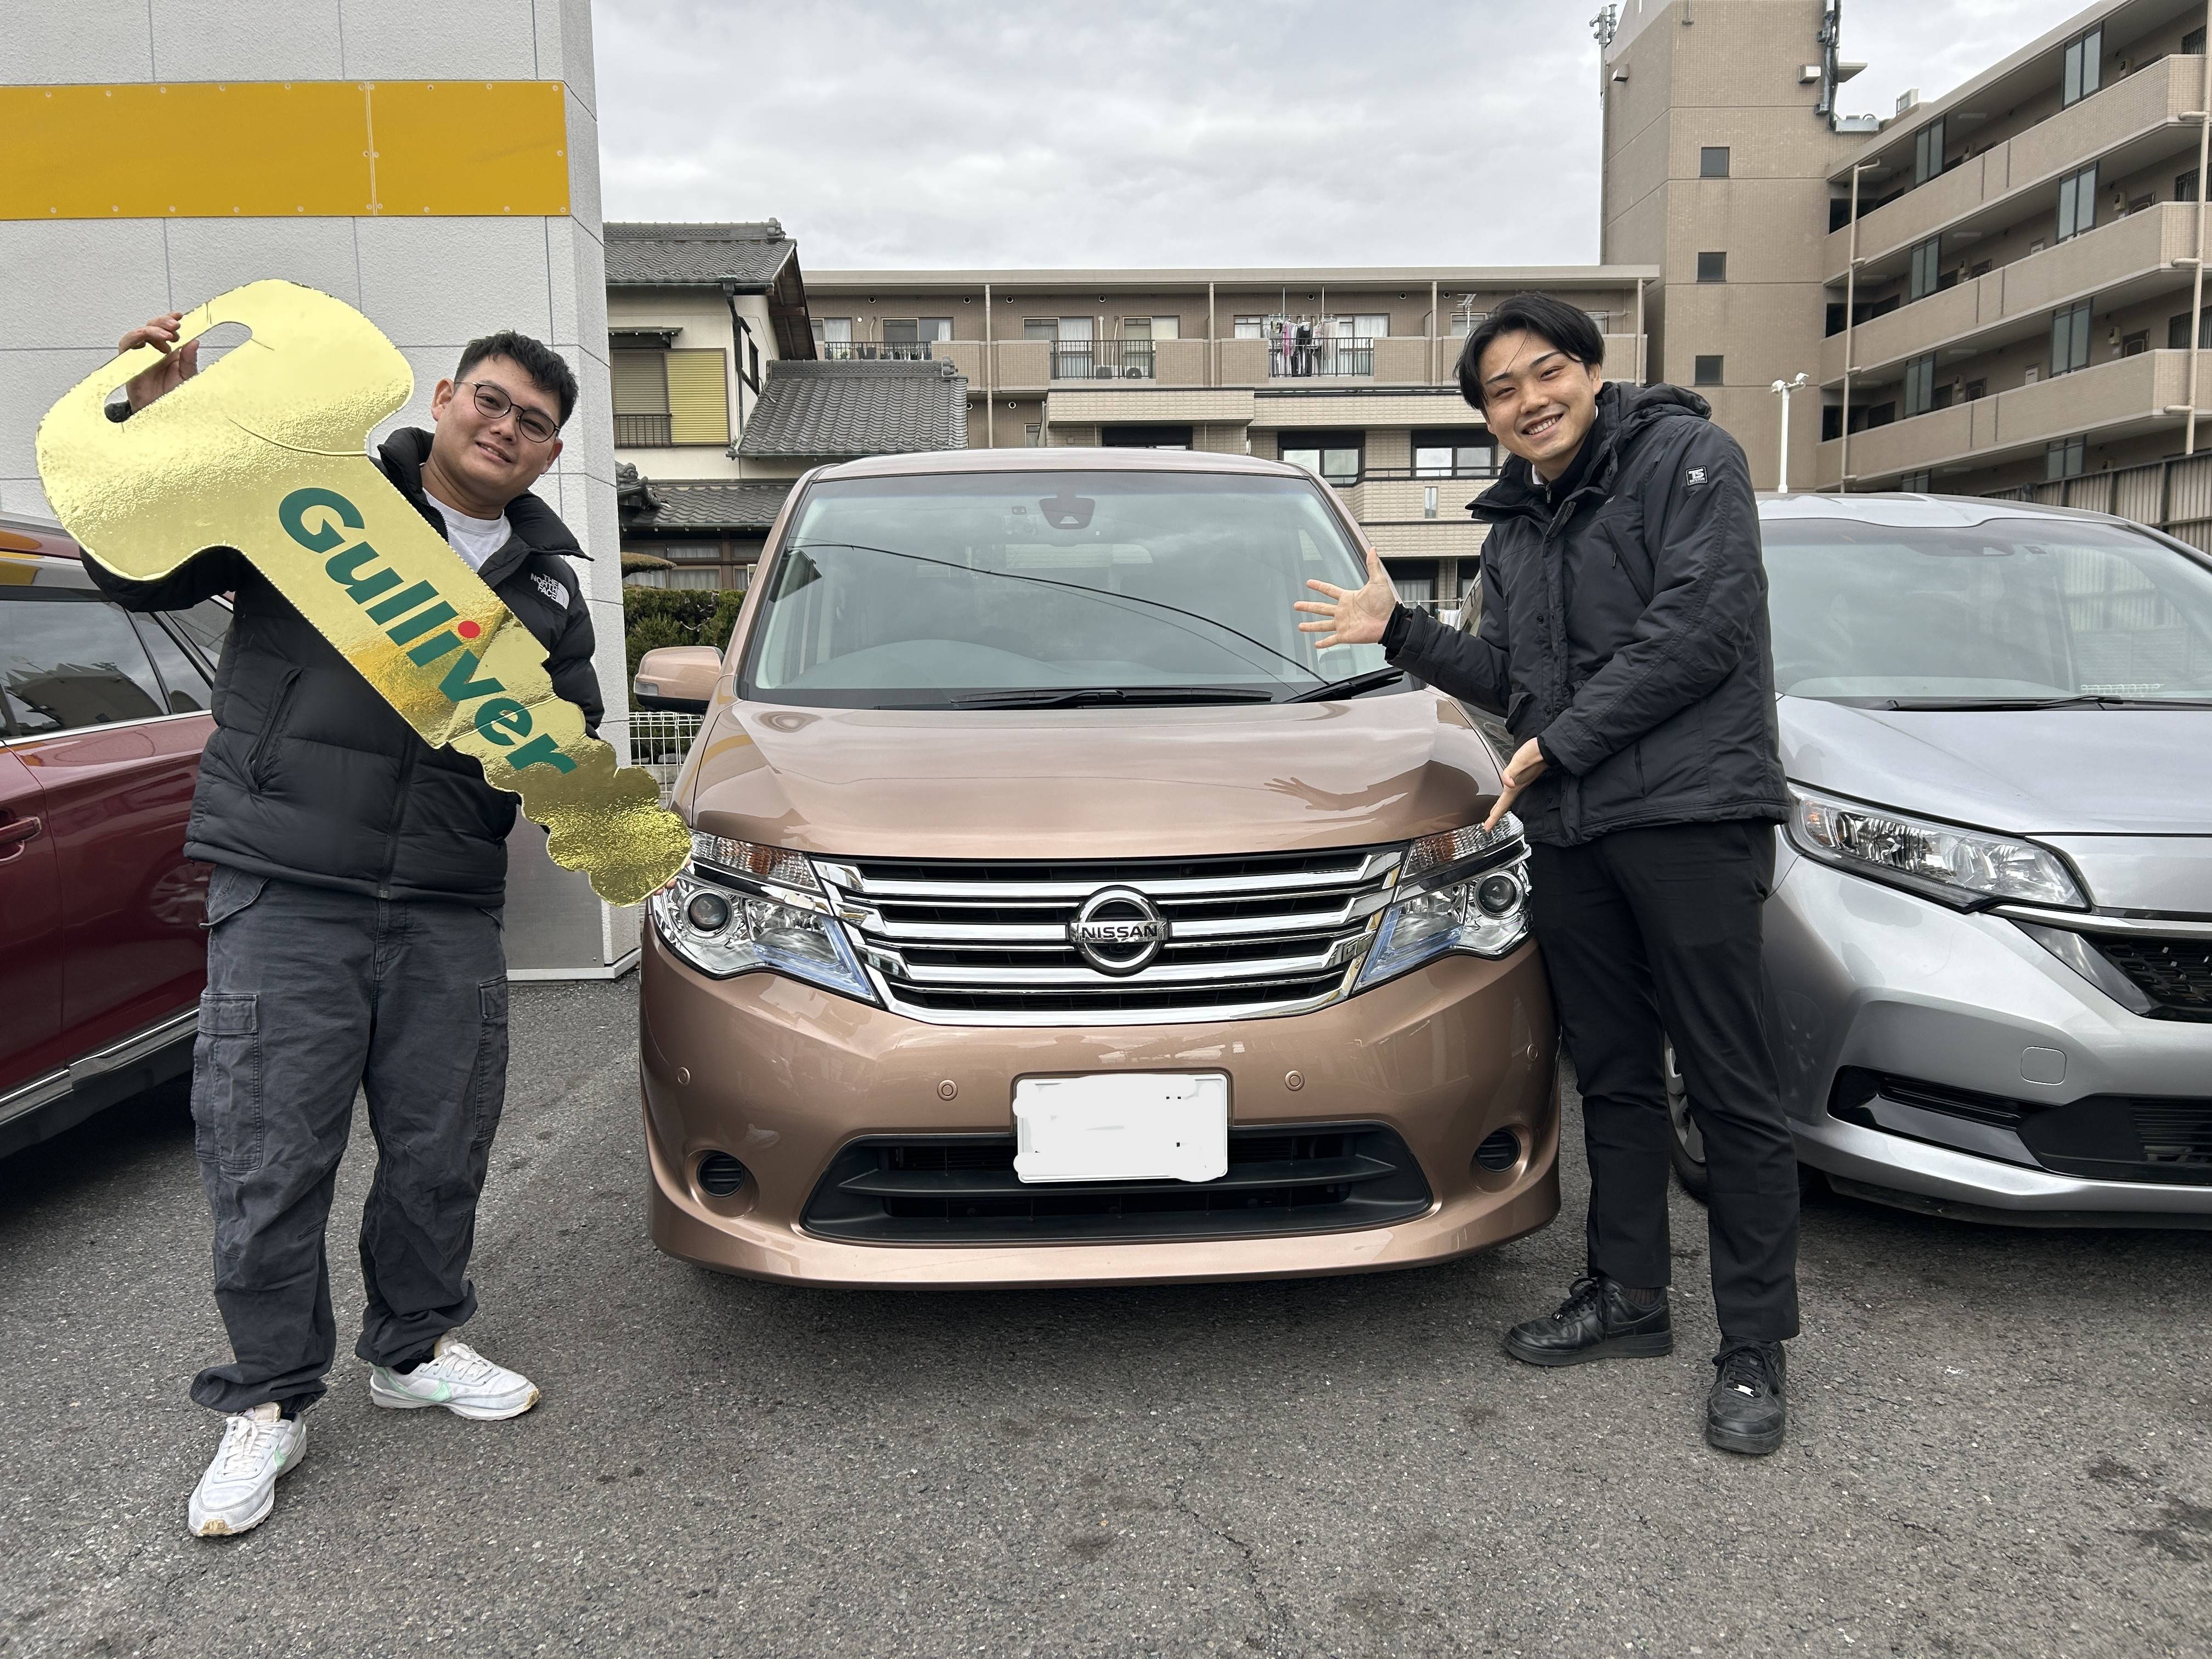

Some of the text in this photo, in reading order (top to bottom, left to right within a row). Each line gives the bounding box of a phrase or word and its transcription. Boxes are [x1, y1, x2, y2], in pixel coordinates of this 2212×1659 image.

[1688, 468, 1704, 479] TS
[531, 573, 558, 593] NORTH
[543, 573, 558, 585] THE
[538, 583, 557, 600] FACE
[278, 487, 578, 775] Gulliver
[1081, 925, 1158, 939] NISSAN
